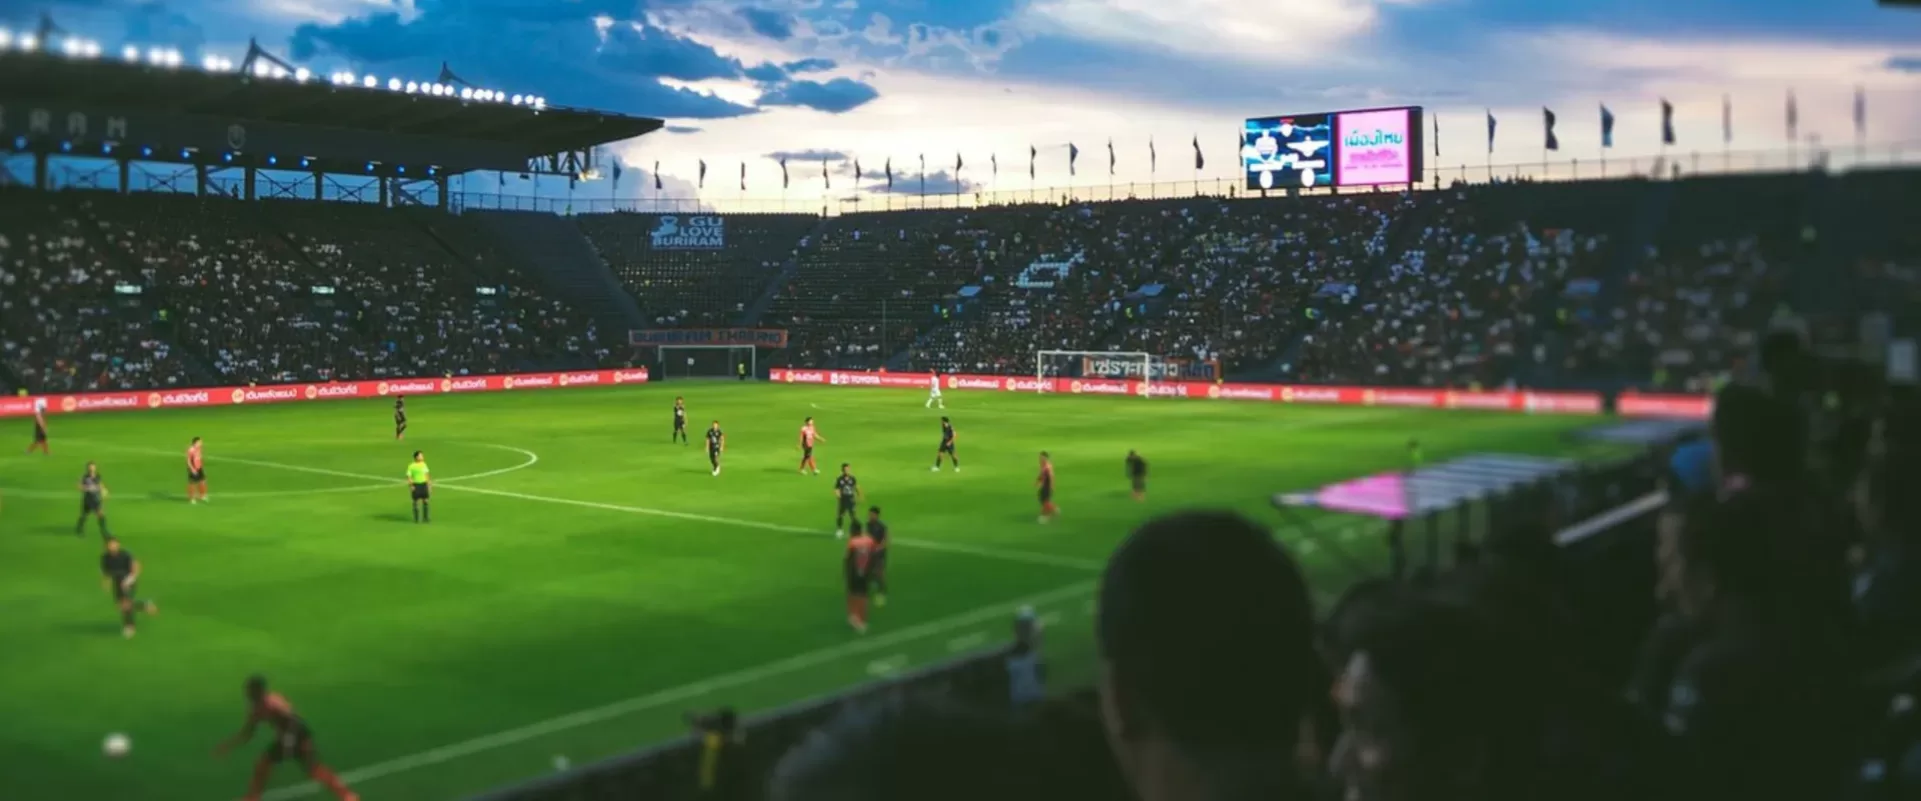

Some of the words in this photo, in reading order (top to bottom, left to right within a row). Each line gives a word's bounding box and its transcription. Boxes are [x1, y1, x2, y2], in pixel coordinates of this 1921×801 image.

[689, 216, 724, 227] GU
[680, 226, 724, 237] LOVE
[652, 236, 723, 246] BURIRAM
